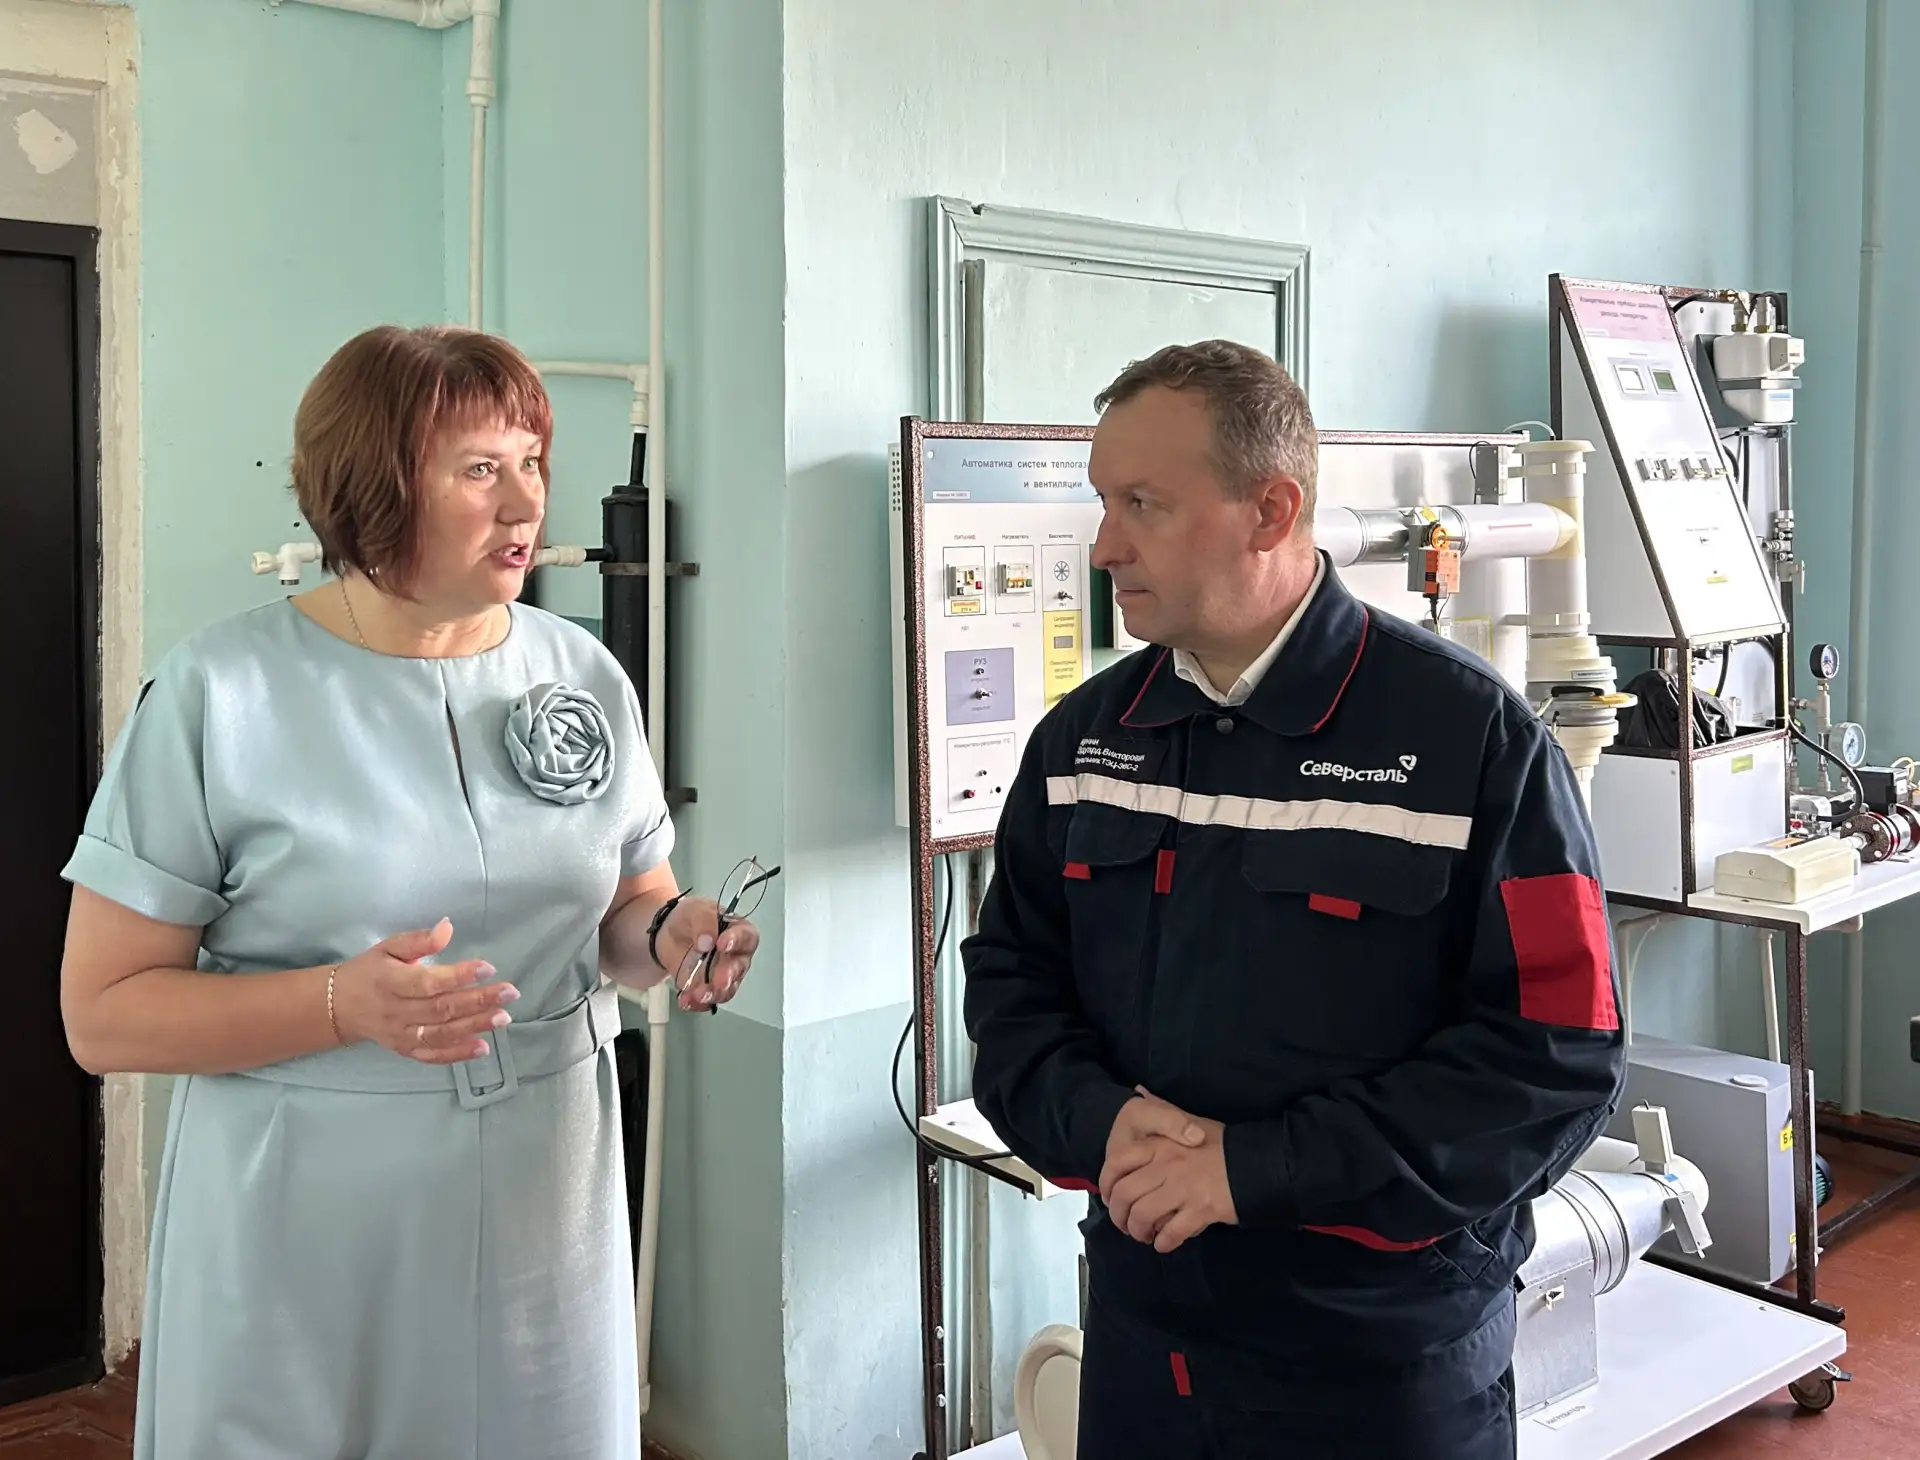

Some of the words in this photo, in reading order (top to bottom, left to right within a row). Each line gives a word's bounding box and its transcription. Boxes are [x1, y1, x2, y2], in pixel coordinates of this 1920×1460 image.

[961, 459, 1013, 468] Автоматика
[1017, 460, 1047, 468] систем
[1033, 481, 1082, 490] вентиляции
[1299, 759, 1408, 784] Северсталь
